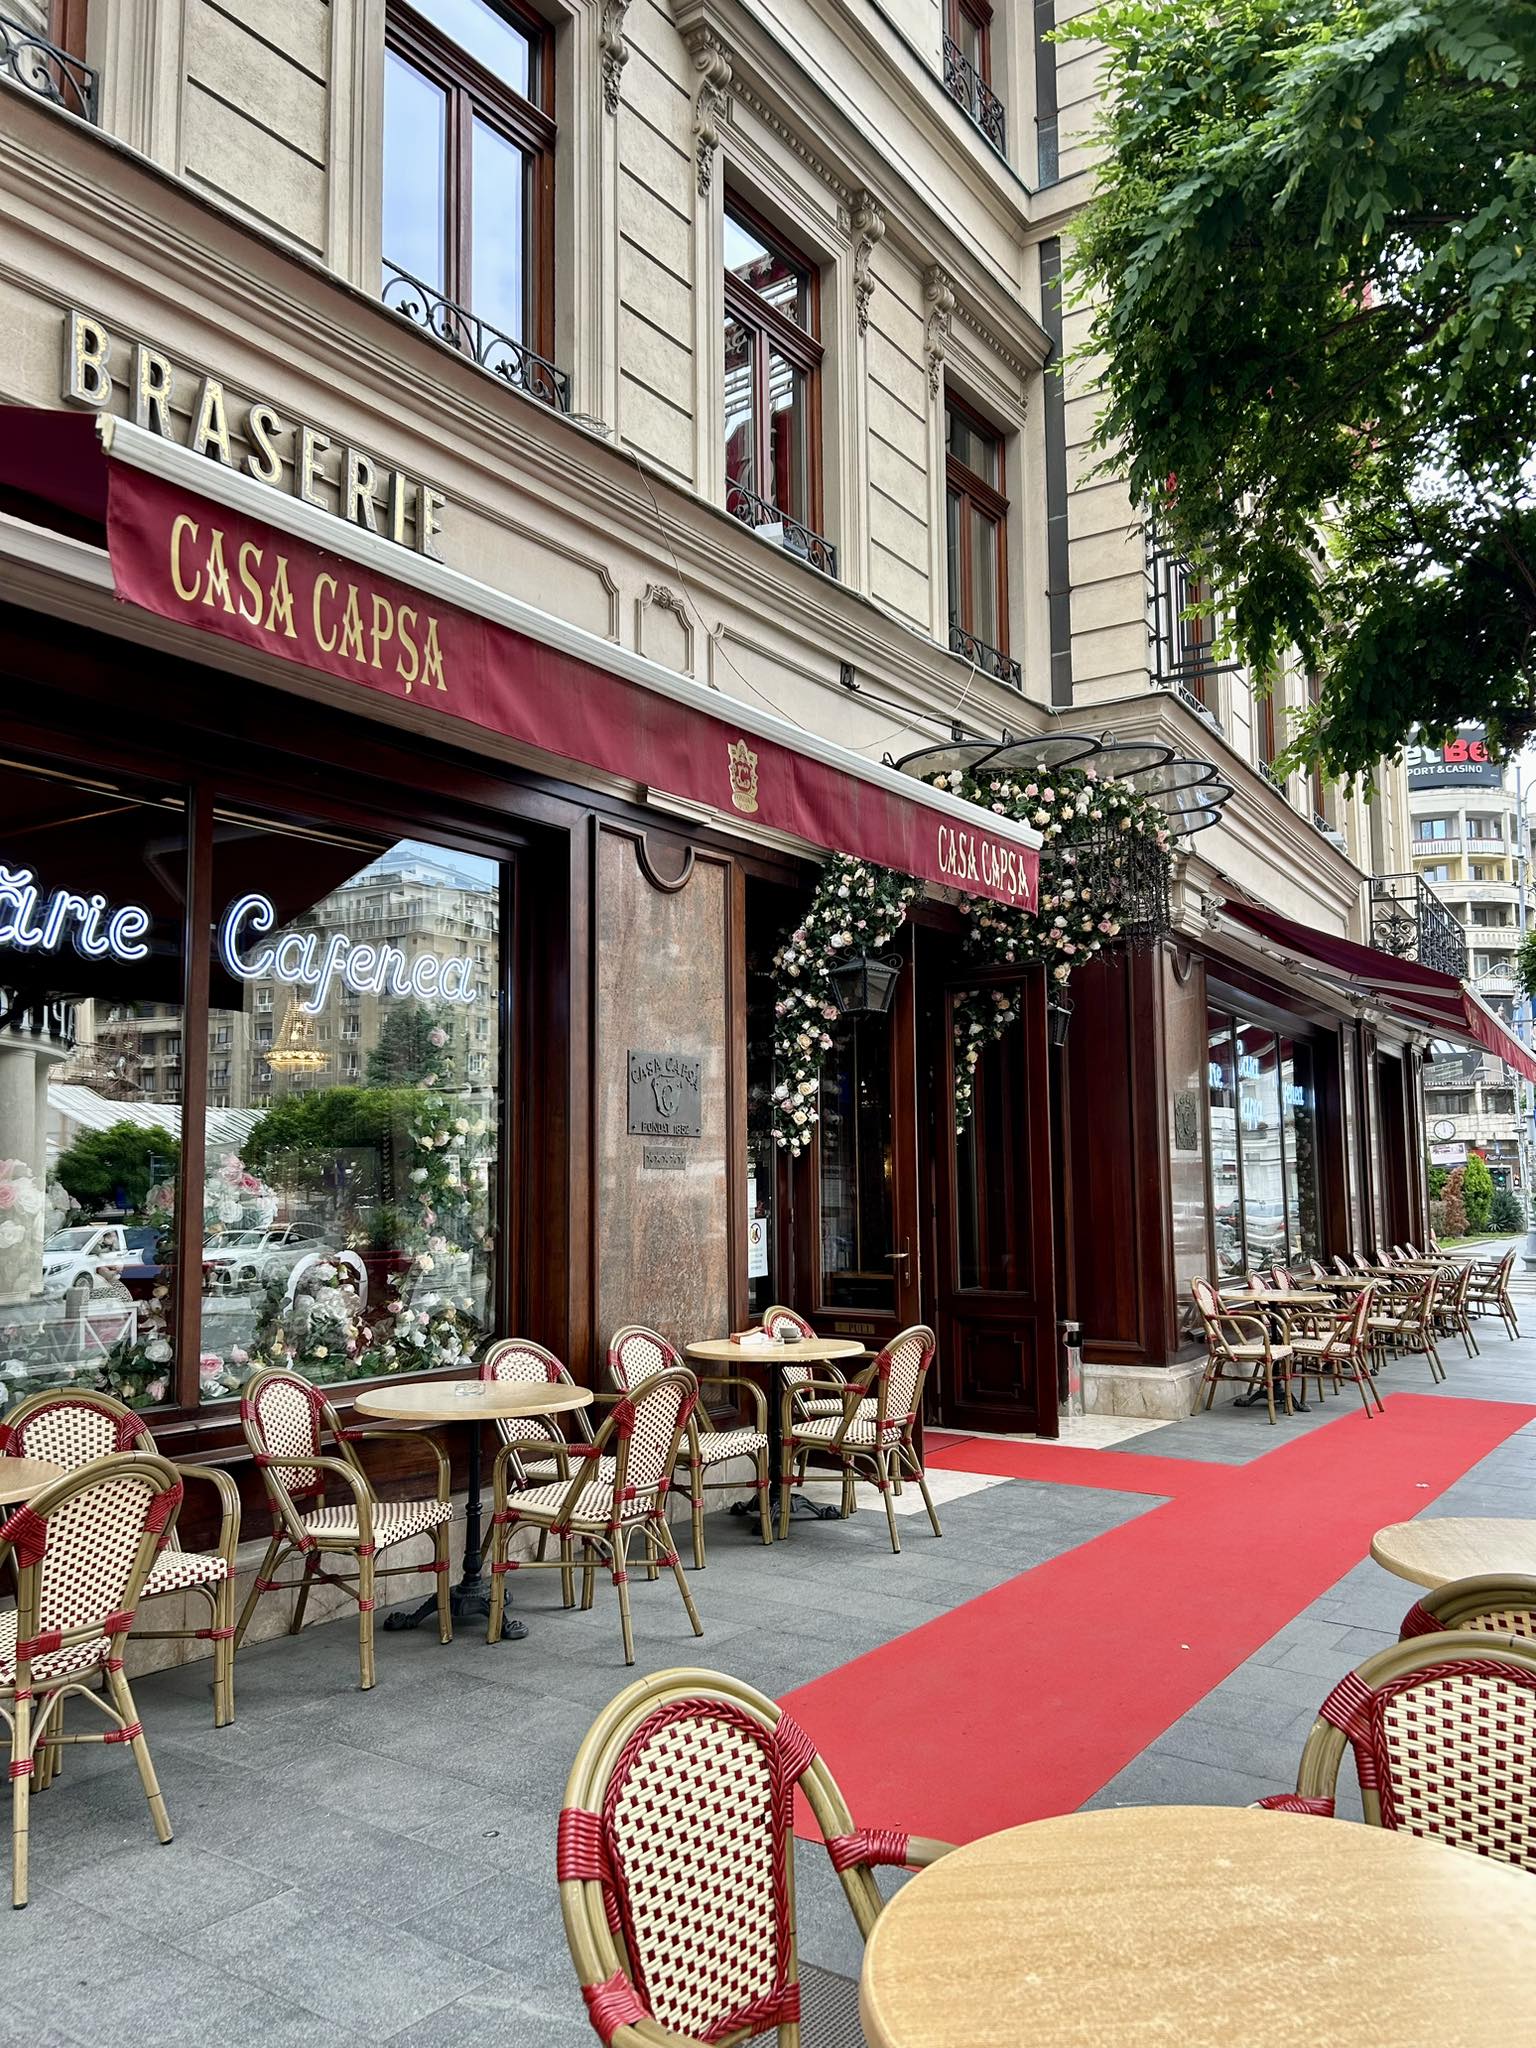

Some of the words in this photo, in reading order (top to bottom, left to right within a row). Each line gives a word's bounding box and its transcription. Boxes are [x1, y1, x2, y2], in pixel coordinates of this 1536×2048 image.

[62, 309, 446, 564] BRASERIE
[170, 514, 299, 640] CASA
[1407, 766, 1436, 777] PORT
[938, 824, 980, 882] CASA
[223, 893, 478, 1014] Cafenea
[630, 1058, 662, 1084] CASA
